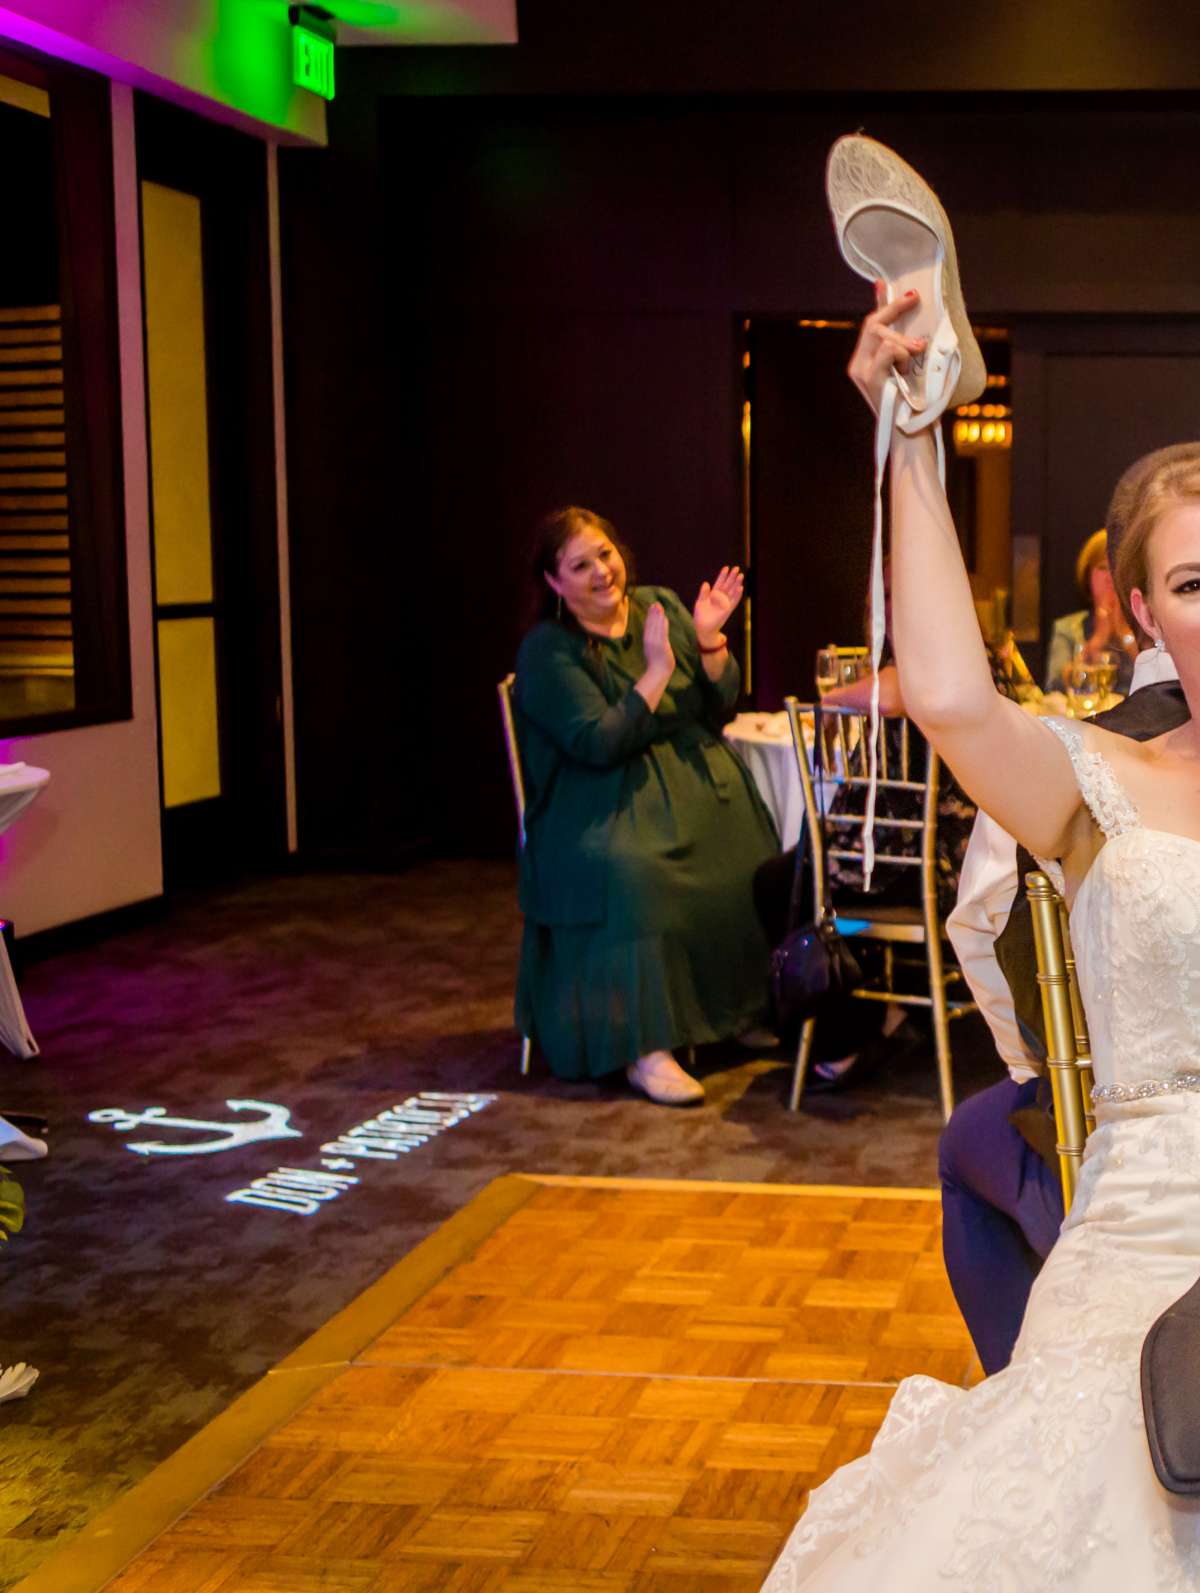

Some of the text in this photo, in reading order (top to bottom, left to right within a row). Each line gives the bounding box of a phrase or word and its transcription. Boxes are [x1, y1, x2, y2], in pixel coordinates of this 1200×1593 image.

[298, 37, 331, 93] EXIT
[225, 1091, 498, 1216] DON + PATRICIA
